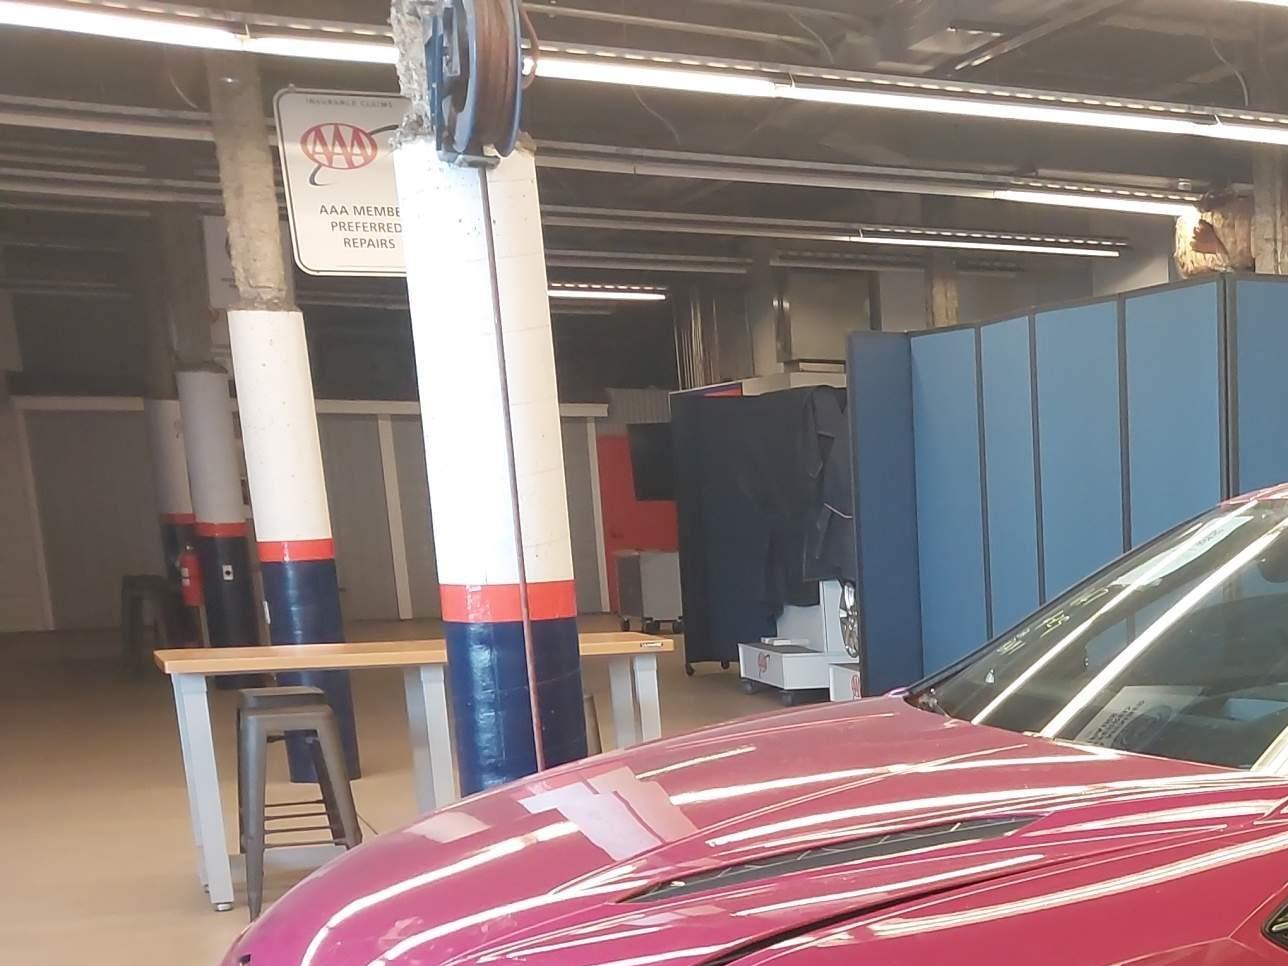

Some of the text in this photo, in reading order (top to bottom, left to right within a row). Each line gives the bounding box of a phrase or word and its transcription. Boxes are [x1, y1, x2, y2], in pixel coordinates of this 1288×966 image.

[304, 123, 375, 169] AAA
[319, 204, 401, 218] AAA MEMBE
[330, 221, 403, 233] PREFERRED
[343, 237, 396, 249] REPAIRS
